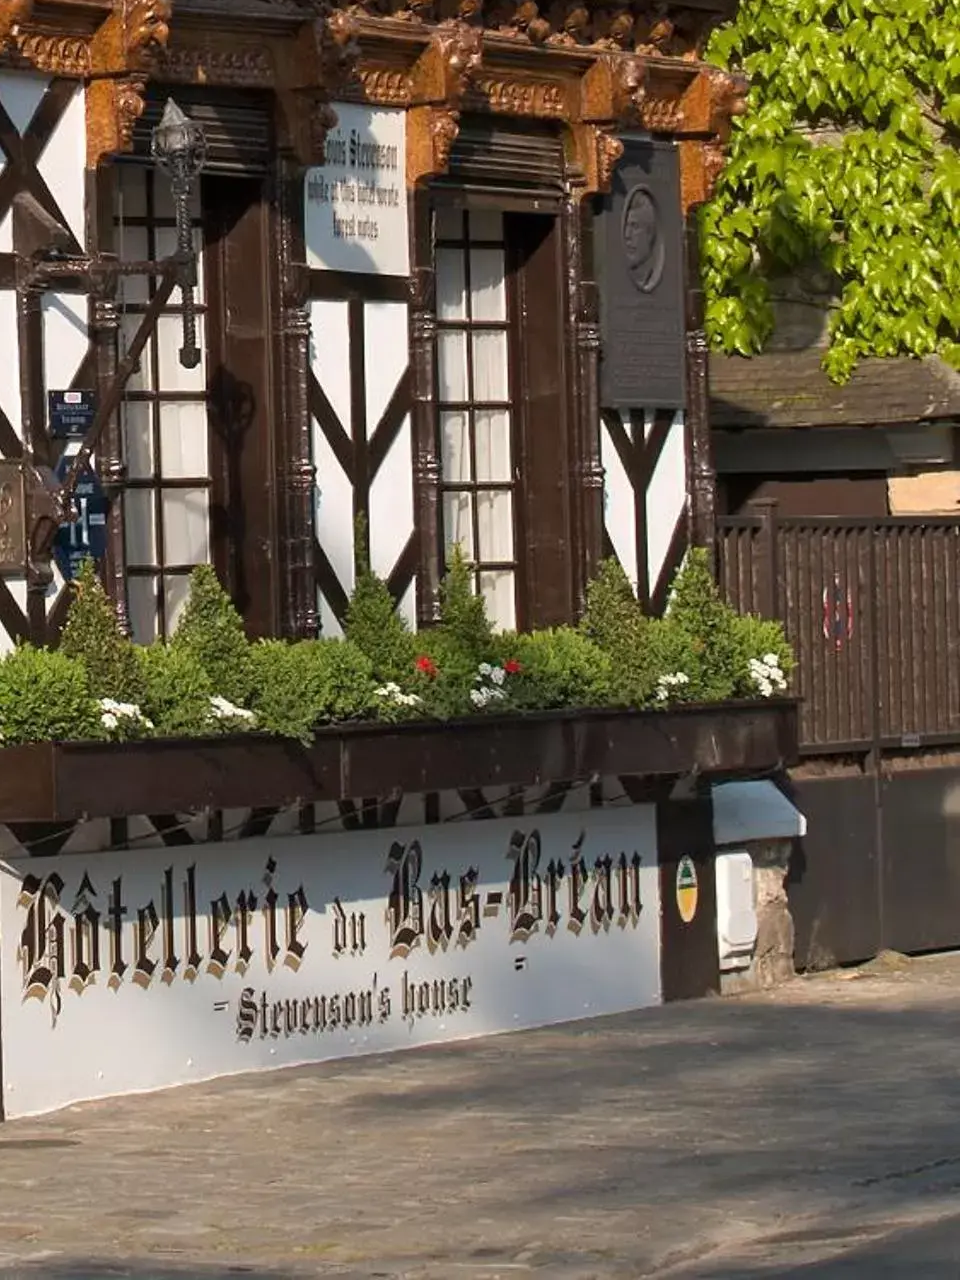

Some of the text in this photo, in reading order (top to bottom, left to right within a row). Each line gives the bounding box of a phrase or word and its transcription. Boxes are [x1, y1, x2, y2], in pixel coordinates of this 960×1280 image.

[332, 895, 366, 958] du
[236, 971, 473, 1043] Stevenson's house
